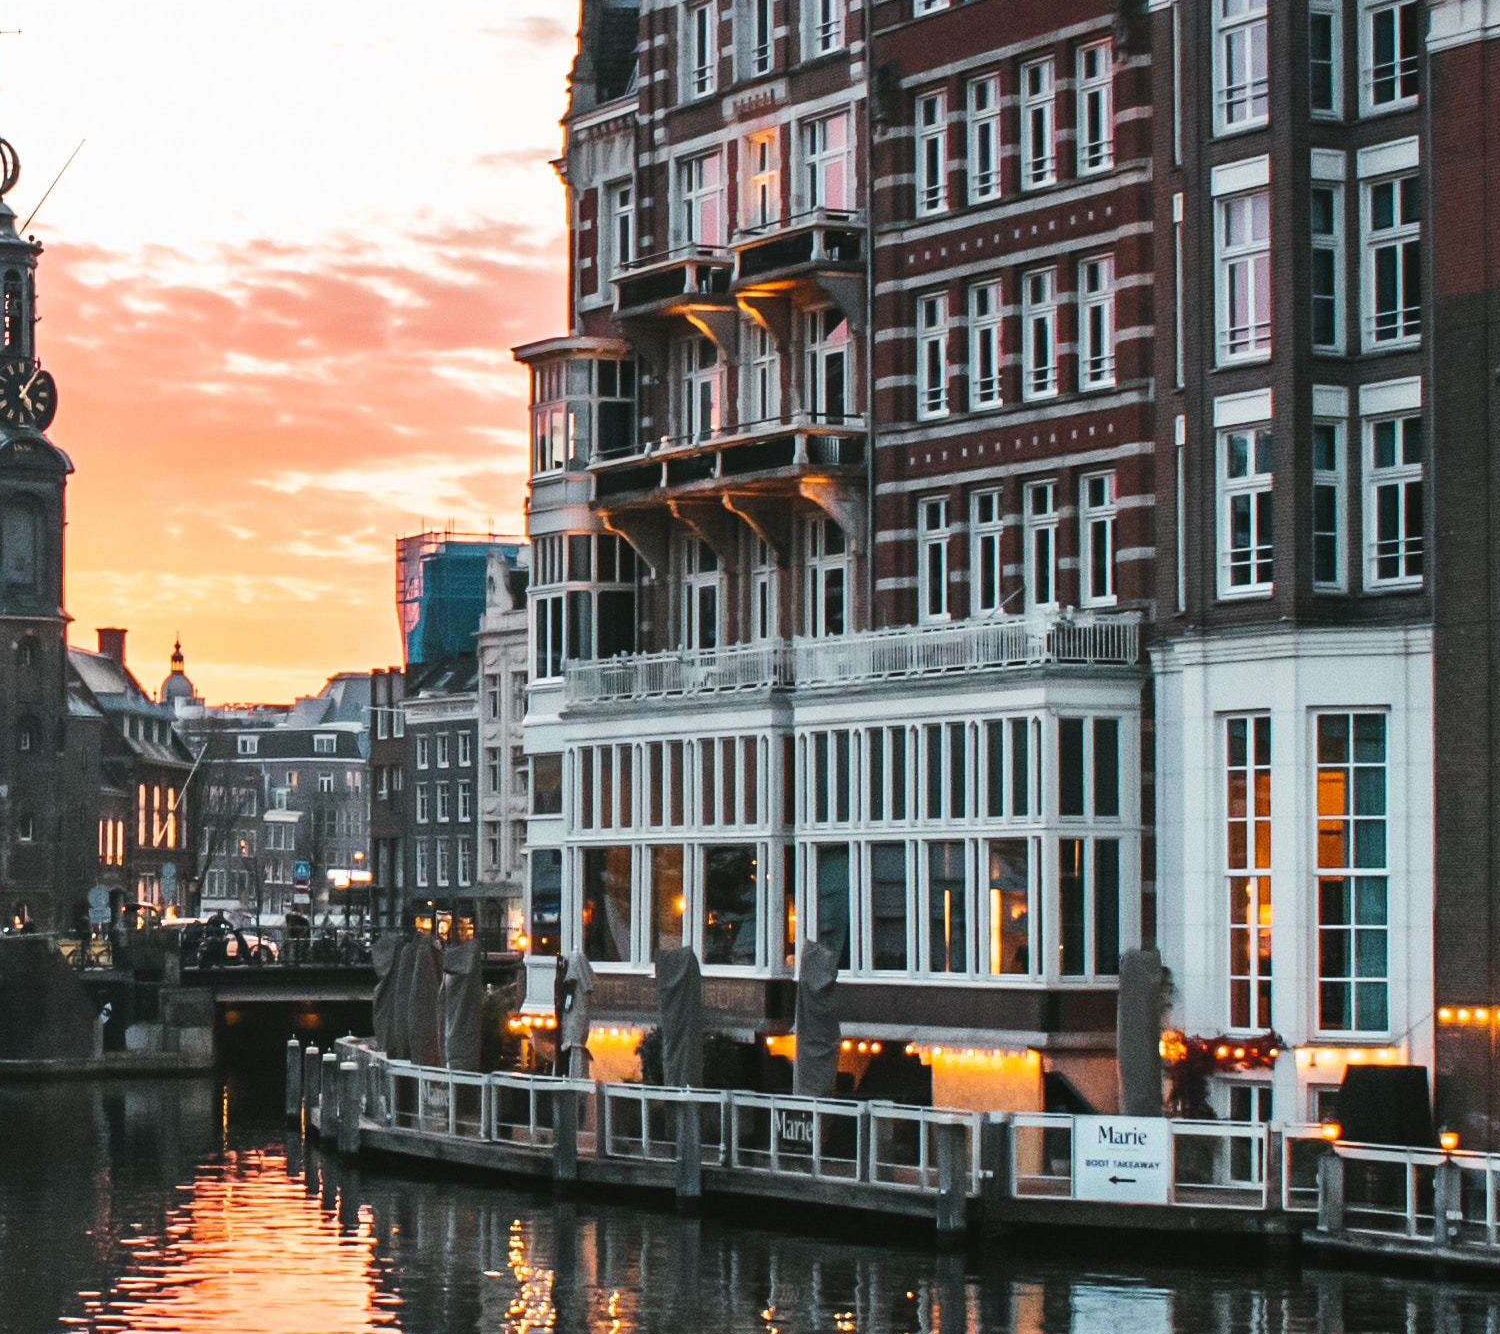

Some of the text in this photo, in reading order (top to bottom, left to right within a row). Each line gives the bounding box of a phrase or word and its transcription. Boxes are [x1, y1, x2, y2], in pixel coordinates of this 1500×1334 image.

[774, 1109, 815, 1142] Marie
[1098, 1125, 1147, 1146] Marie
[1113, 1160, 1160, 1169] TAKEAWAY
